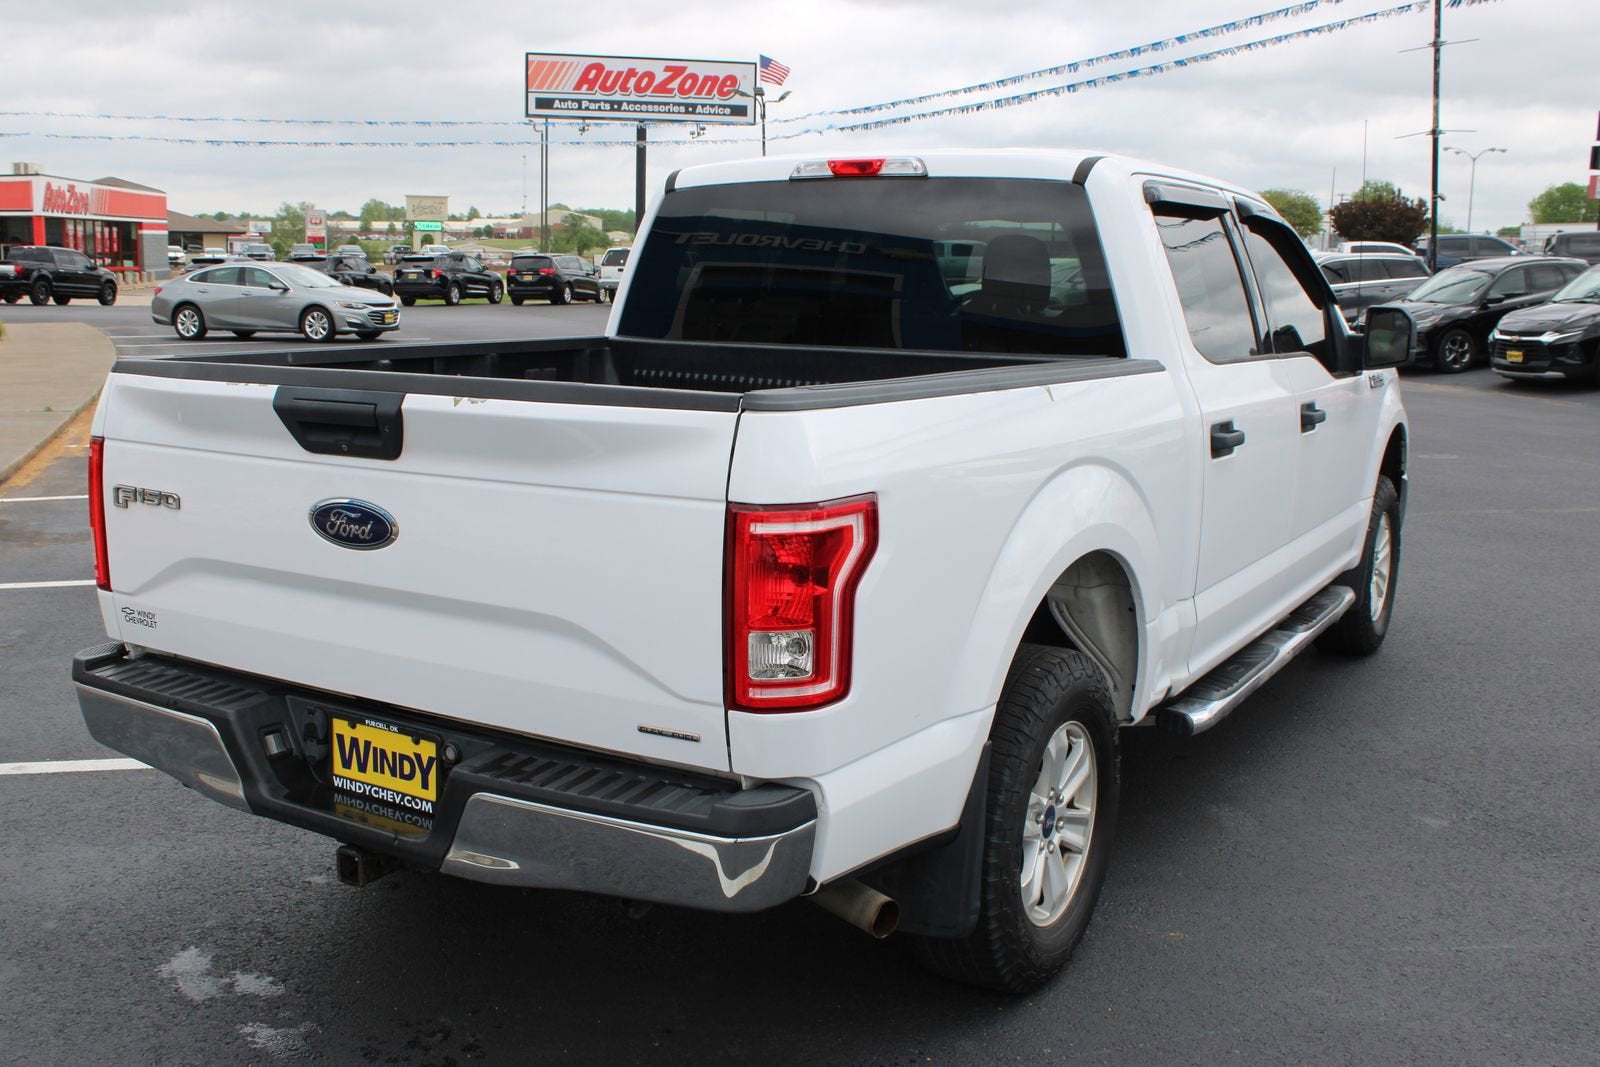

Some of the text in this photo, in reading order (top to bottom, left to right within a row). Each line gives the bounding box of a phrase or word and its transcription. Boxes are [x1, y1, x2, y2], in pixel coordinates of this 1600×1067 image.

[572, 62, 741, 99] AutoZone
[553, 98, 731, 116] Auto Parts Accessories Advice
[42, 181, 89, 216] AutoZone
[326, 508, 374, 540] Ford
[124, 614, 158, 629] CHEVROLET
[389, 722, 399, 733] OK
[335, 732, 437, 791] WINDY
[332, 775, 434, 814] WINDYCHEV.COM
